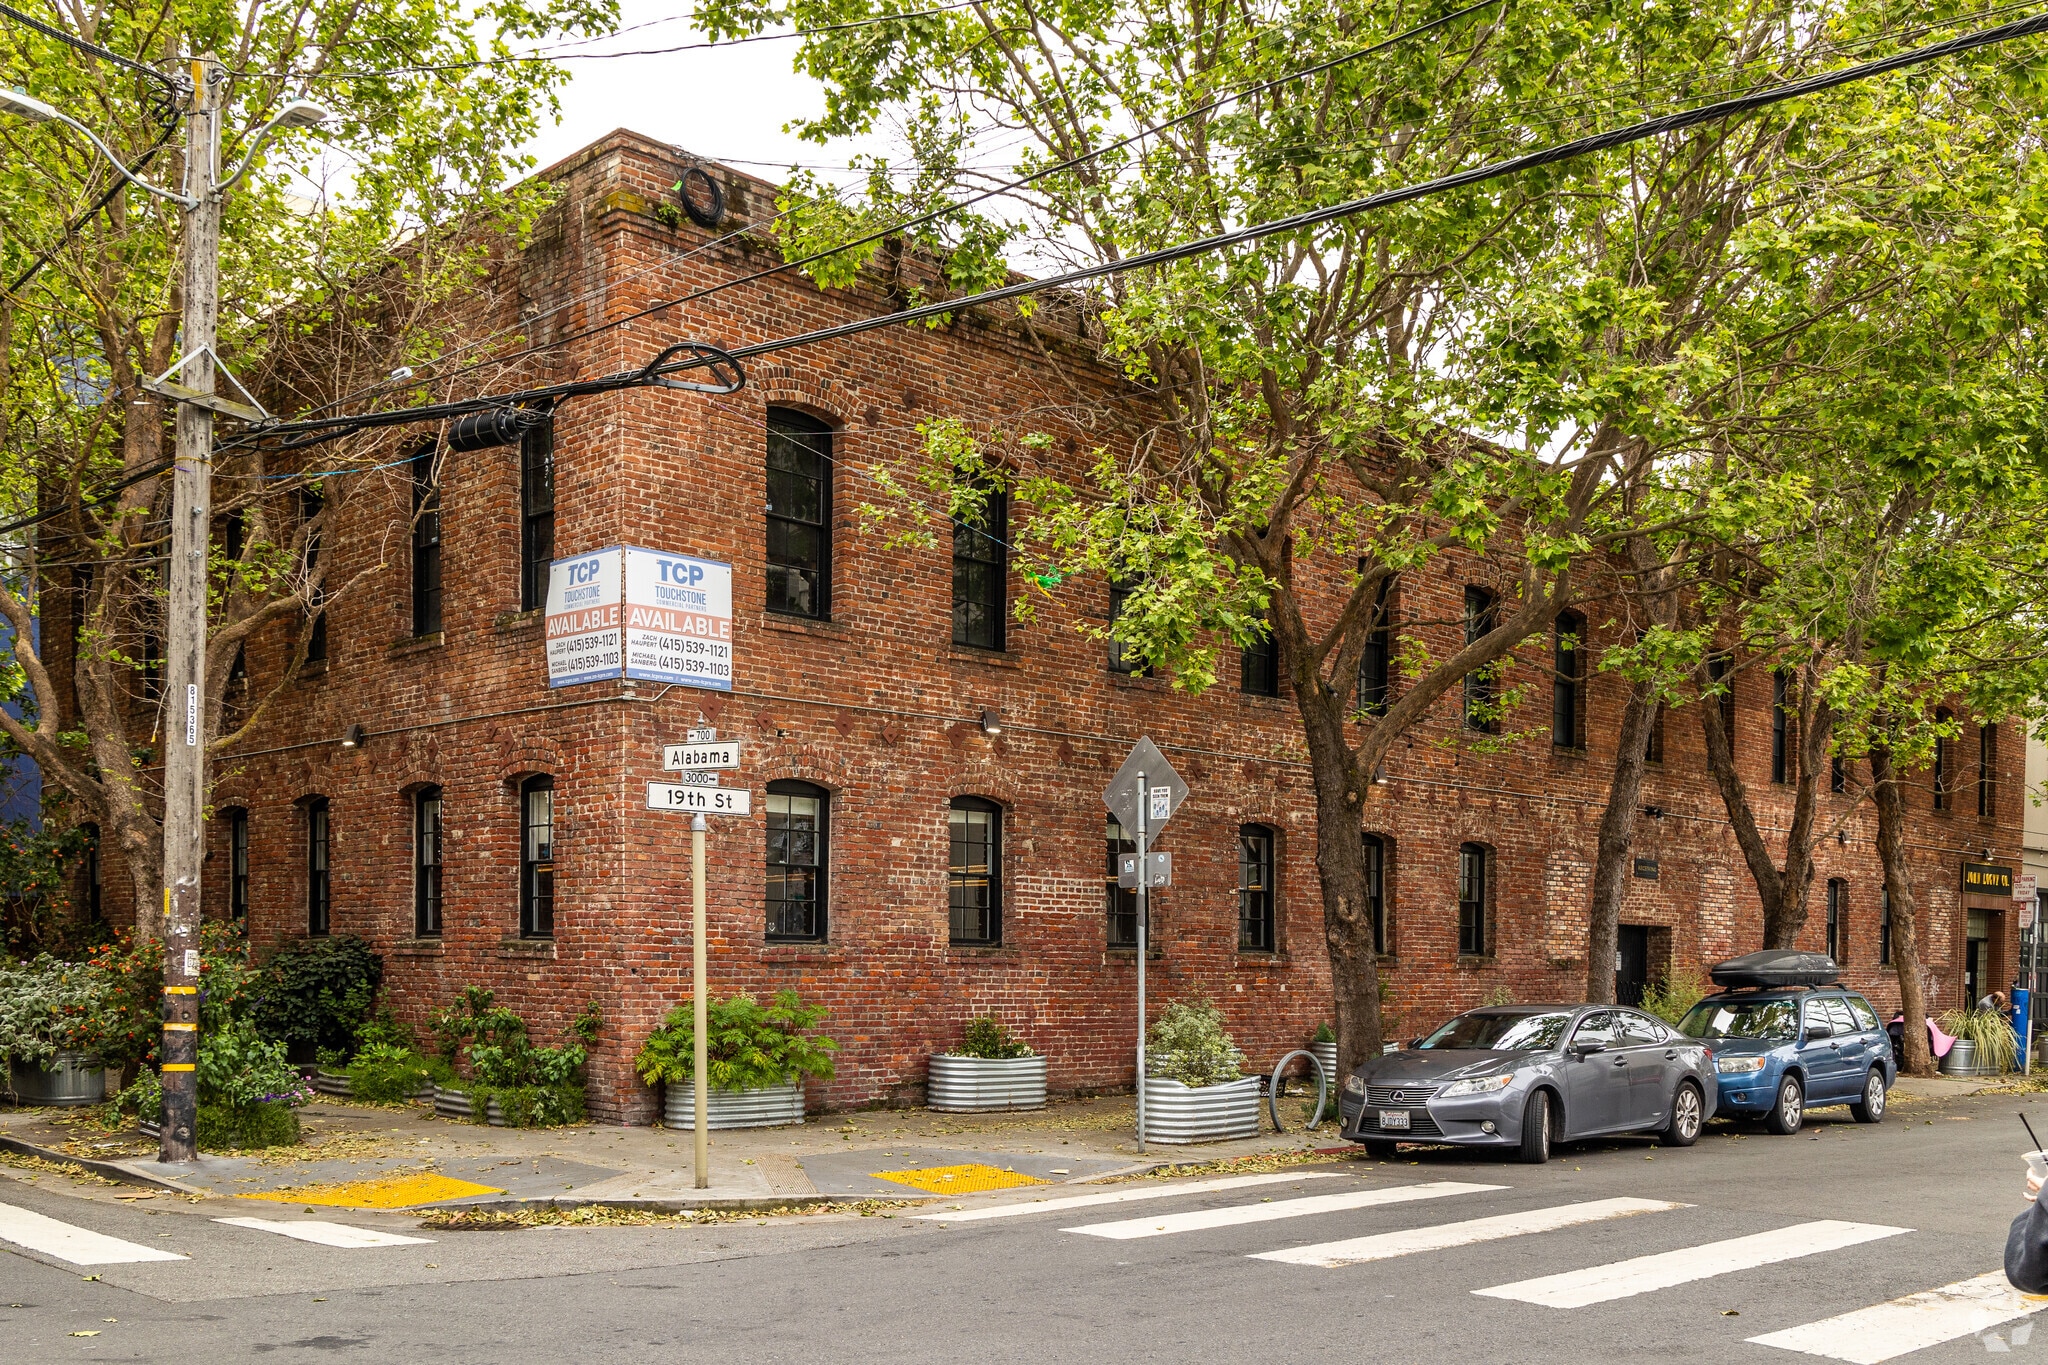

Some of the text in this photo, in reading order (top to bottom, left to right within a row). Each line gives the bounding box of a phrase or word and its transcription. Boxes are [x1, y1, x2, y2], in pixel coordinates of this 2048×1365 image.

[568, 559, 600, 586] TCP
[656, 559, 704, 586] TCP
[564, 585, 600, 603] TOUCHSTONE
[655, 585, 706, 605] TOUCHSTONE
[656, 599, 707, 612] COMMERCIAL PARTNERS
[547, 606, 619, 637] AVAILABLE
[629, 607, 730, 640] AVAILABLE
[631, 639, 657, 648] HAUPERT
[630, 658, 657, 667] SANBERG
[632, 652, 656, 660] MICHAEL
[696, 730, 710, 740] 700
[672, 750, 729, 765] Alabama
[685, 772, 708, 783] 3000
[667, 789, 732, 809] 19th St
